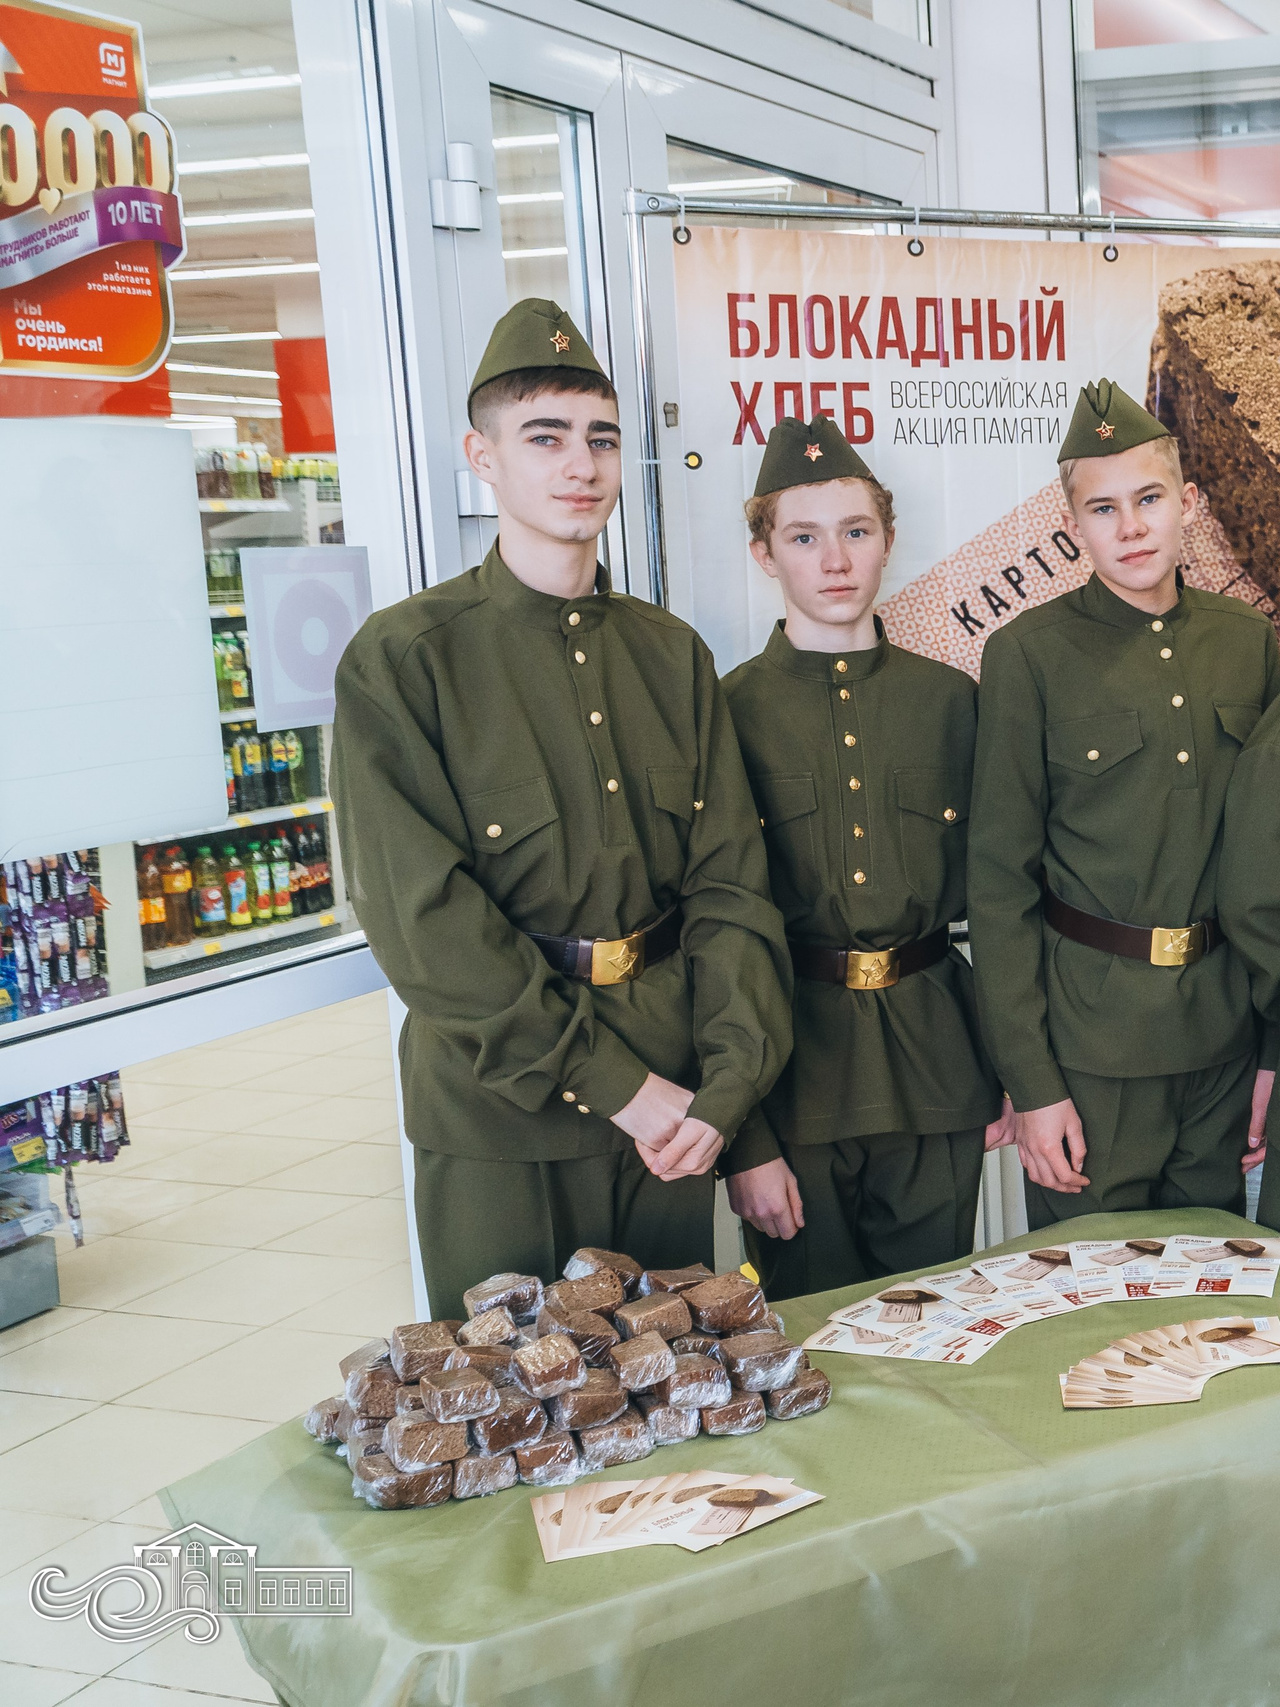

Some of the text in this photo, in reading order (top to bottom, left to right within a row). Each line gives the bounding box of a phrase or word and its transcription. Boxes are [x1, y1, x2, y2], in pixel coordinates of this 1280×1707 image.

[101, 77, 128, 88] МАГНИТ
[48, 210, 91, 236] РАБОТАЮТ
[108, 200, 164, 227] 10 ЛЕТ
[0, 227, 80, 268] МАГНИТЕ» БОЛЬШЕ
[103, 272, 145, 284] работает
[121, 263, 132, 272] из
[133, 264, 150, 274] них
[87, 282, 153, 297] этом магазине
[13, 298, 42, 316] Мы
[15, 317, 66, 334] очень
[726, 286, 1066, 368] БЛОКАДНЫЙ
[17, 333, 104, 353] гордимся!
[890, 376, 1068, 409] ВСЕРОССИЙСКАЯ
[730, 381, 874, 446] ХЛЕБ
[892, 417, 1062, 448] АКЦИЯ ПАМЯТИ
